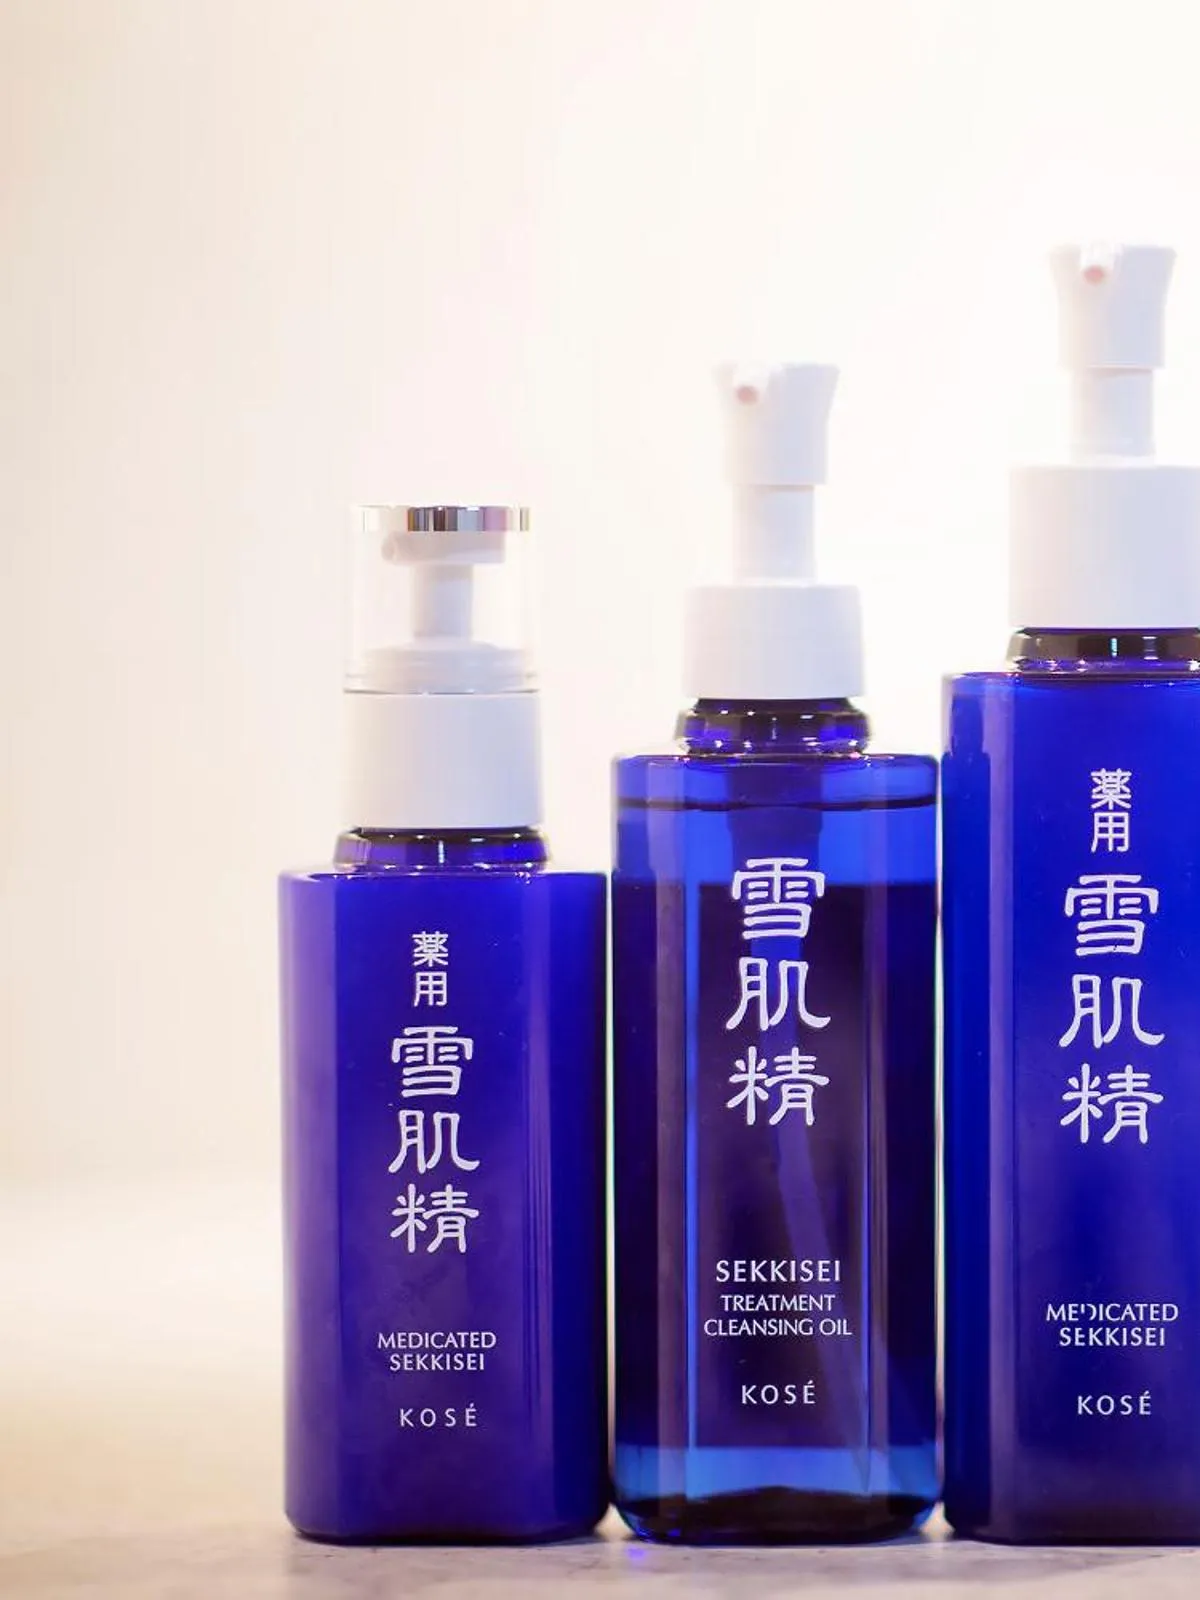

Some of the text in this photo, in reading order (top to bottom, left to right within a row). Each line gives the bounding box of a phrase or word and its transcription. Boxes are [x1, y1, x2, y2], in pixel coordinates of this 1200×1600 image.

[1090, 767, 1133, 853] 薬用
[411, 930, 449, 1007] 薬用
[725, 857, 831, 1127] 雪肌精
[1058, 874, 1165, 1145] 雪肌精
[388, 1025, 481, 1254] 雪肌精
[715, 1259, 840, 1283] SEKKISEI
[720, 1294, 836, 1312] TREATMENT
[703, 1318, 853, 1336] CLEANSING OIL
[1059, 1326, 1166, 1347] SEKKISEI
[377, 1331, 497, 1350] MEDICATED
[389, 1353, 485, 1372] SEKKISEI
[741, 1379, 816, 1405] KOSÉ
[1077, 1390, 1151, 1416] KOSÉ
[399, 1402, 477, 1428] KOSÉ
